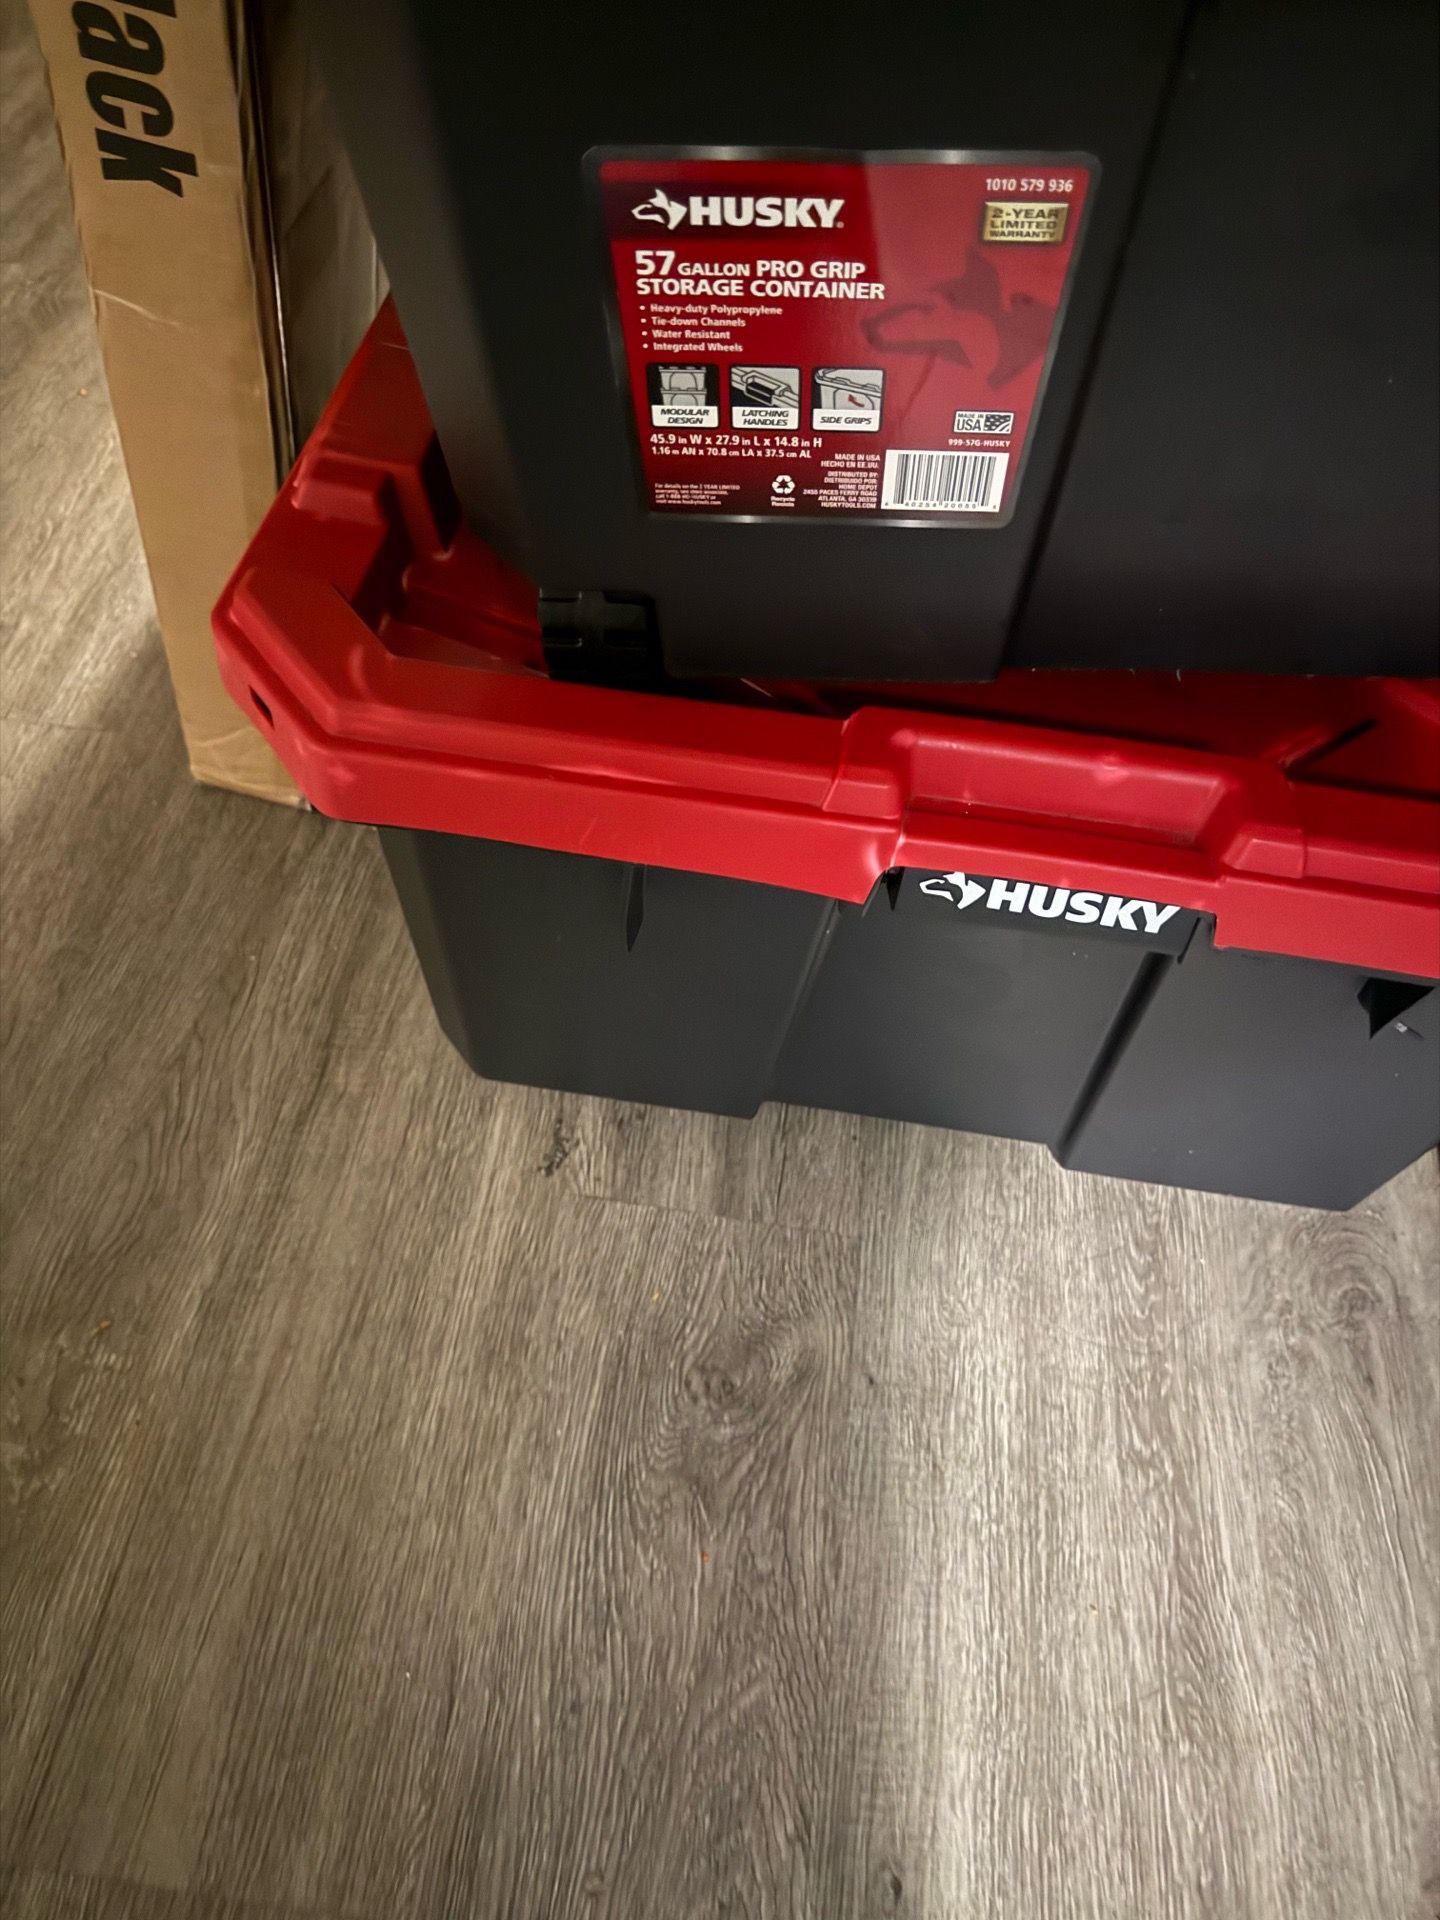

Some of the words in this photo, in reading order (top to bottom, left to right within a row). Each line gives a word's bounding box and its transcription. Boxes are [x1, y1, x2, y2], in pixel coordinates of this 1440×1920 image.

[71, 0, 199, 198] ack
[985, 178, 1017, 191] 1010
[1020, 179, 1045, 191] 579
[1048, 179, 1074, 192] 936
[991, 208, 1059, 219] 2-YEAR
[990, 220, 1058, 230] LIMITED
[989, 230, 1056, 238] WARRANTY
[634, 250, 676, 276] 57
[677, 262, 750, 278] GALLON
[756, 259, 803, 278] PRO
[810, 261, 866, 279] GRIP
[636, 278, 744, 297] STORAGE
[750, 279, 885, 300] CONTAINER
[650, 304, 709, 316] Heavy-duty
[710, 305, 783, 317] Polypropylene
[651, 316, 699, 326] Tie-down
[700, 317, 747, 327] Channels
[651, 329, 682, 339] Water
[684, 330, 731, 339] Resistant
[653, 342, 705, 353] Integrated
[706, 342, 744, 352] Wheels
[660, 408, 710, 416] MODULAR
[741, 409, 789, 418] LATCHING
[667, 416, 704, 425] DESIGN
[743, 418, 788, 427] HANDLES
[819, 416, 842, 424] SIDE
[843, 416, 872, 425] GRIPS
[957, 419, 982, 431] USA
[650, 433, 676, 445] 45.9
[678, 435, 687, 444] in
[689, 434, 703, 445] W
[705, 436, 712, 445] x
[715, 435, 740, 446] 27.9
[741, 436, 751, 446] in
[753, 436, 761, 446] L
[763, 438, 770, 446] x
[774, 436, 799, 447] 14.8
[800, 437, 810, 447] in
[812, 437, 822, 448] H
[651, 446, 671, 455] 1.16
[681, 447, 696, 456] AN
[698, 448, 704, 456] x
[706, 447, 727, 457] 70.8
[741, 448, 755, 457] LA
[764, 448, 784, 458] 37.5
[799, 449, 812, 458] AL
[986, 878, 1181, 934] HUSKY
